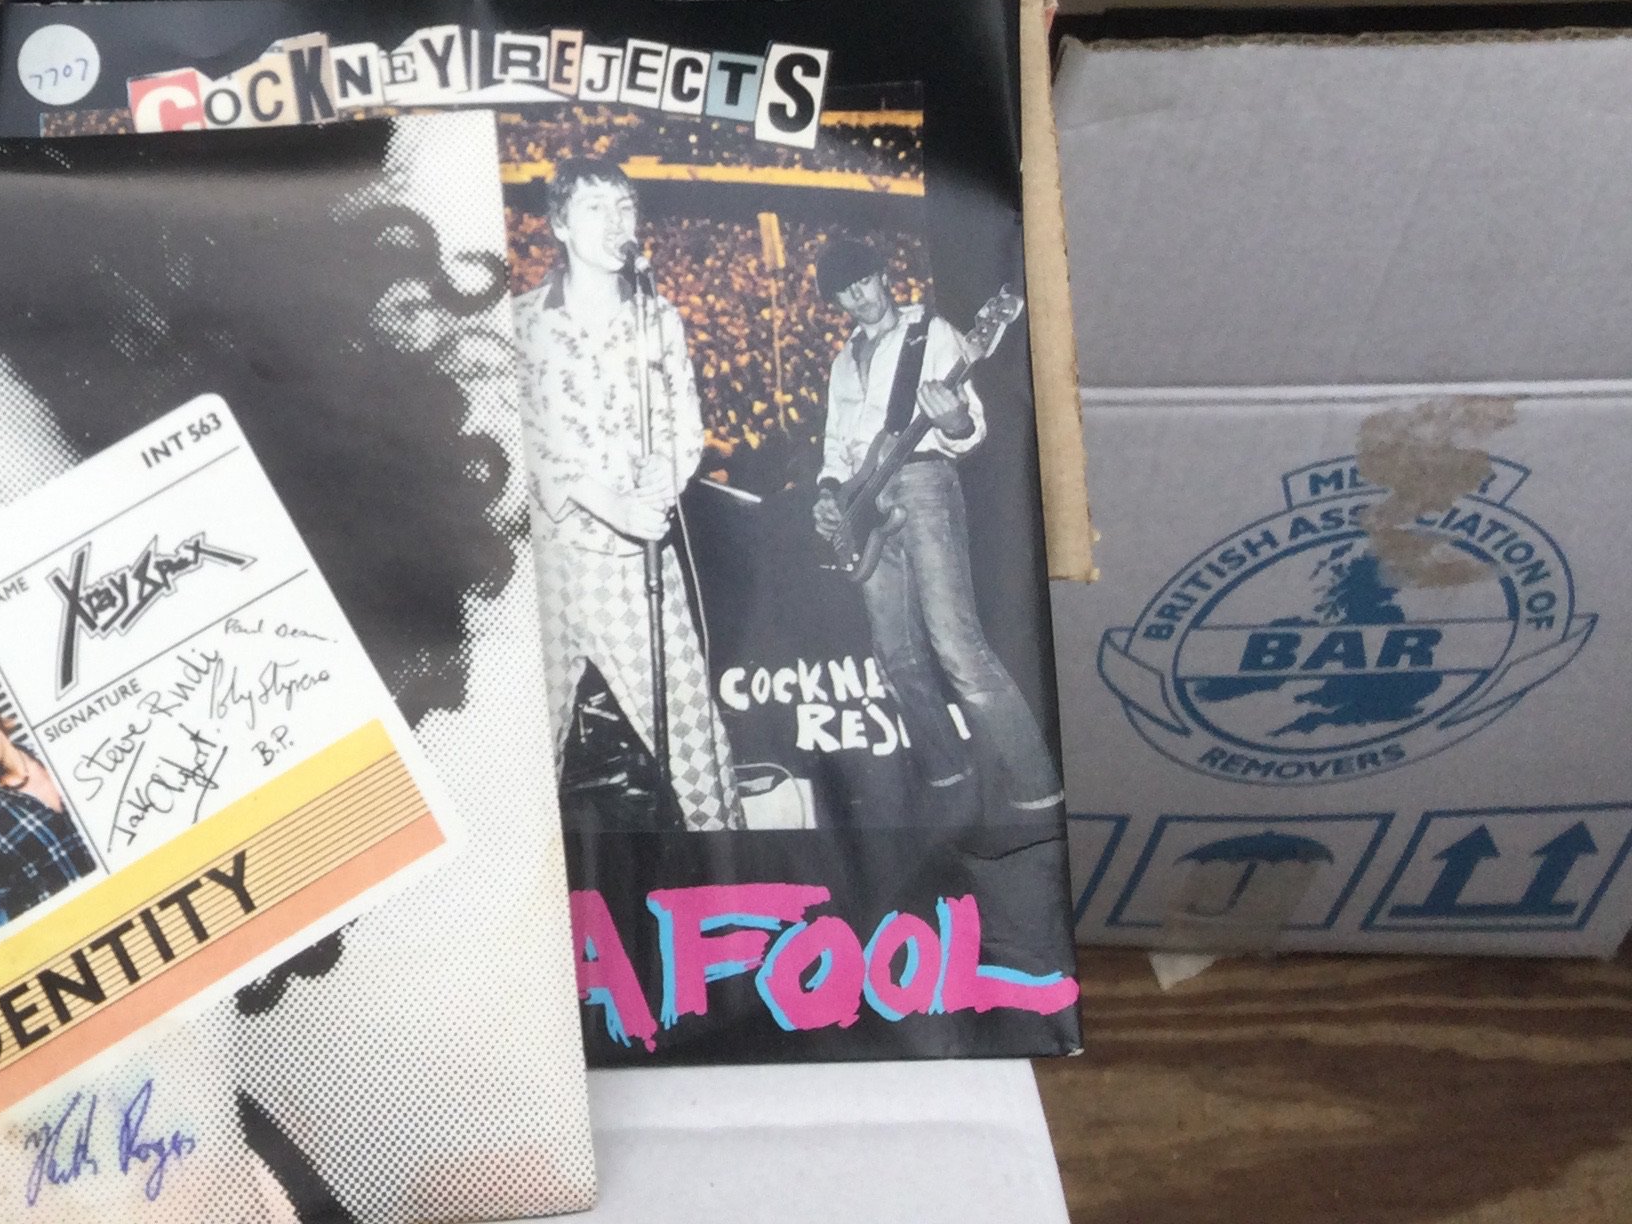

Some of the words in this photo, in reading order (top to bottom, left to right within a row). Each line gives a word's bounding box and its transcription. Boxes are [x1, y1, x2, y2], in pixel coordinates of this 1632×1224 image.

[135, 32, 461, 132] COCKNEY
[498, 38, 822, 134] REJECTS
[140, 431, 184, 469] INT
[187, 412, 223, 443] 563
[1141, 528, 1280, 641] BRITISH
[1525, 590, 1558, 630] OF
[1239, 628, 1444, 674] BAR
[42, 676, 143, 744] SIGNATURE
[1198, 743, 1408, 779] REMOVERS
[646, 883, 1080, 1031] FOOL
